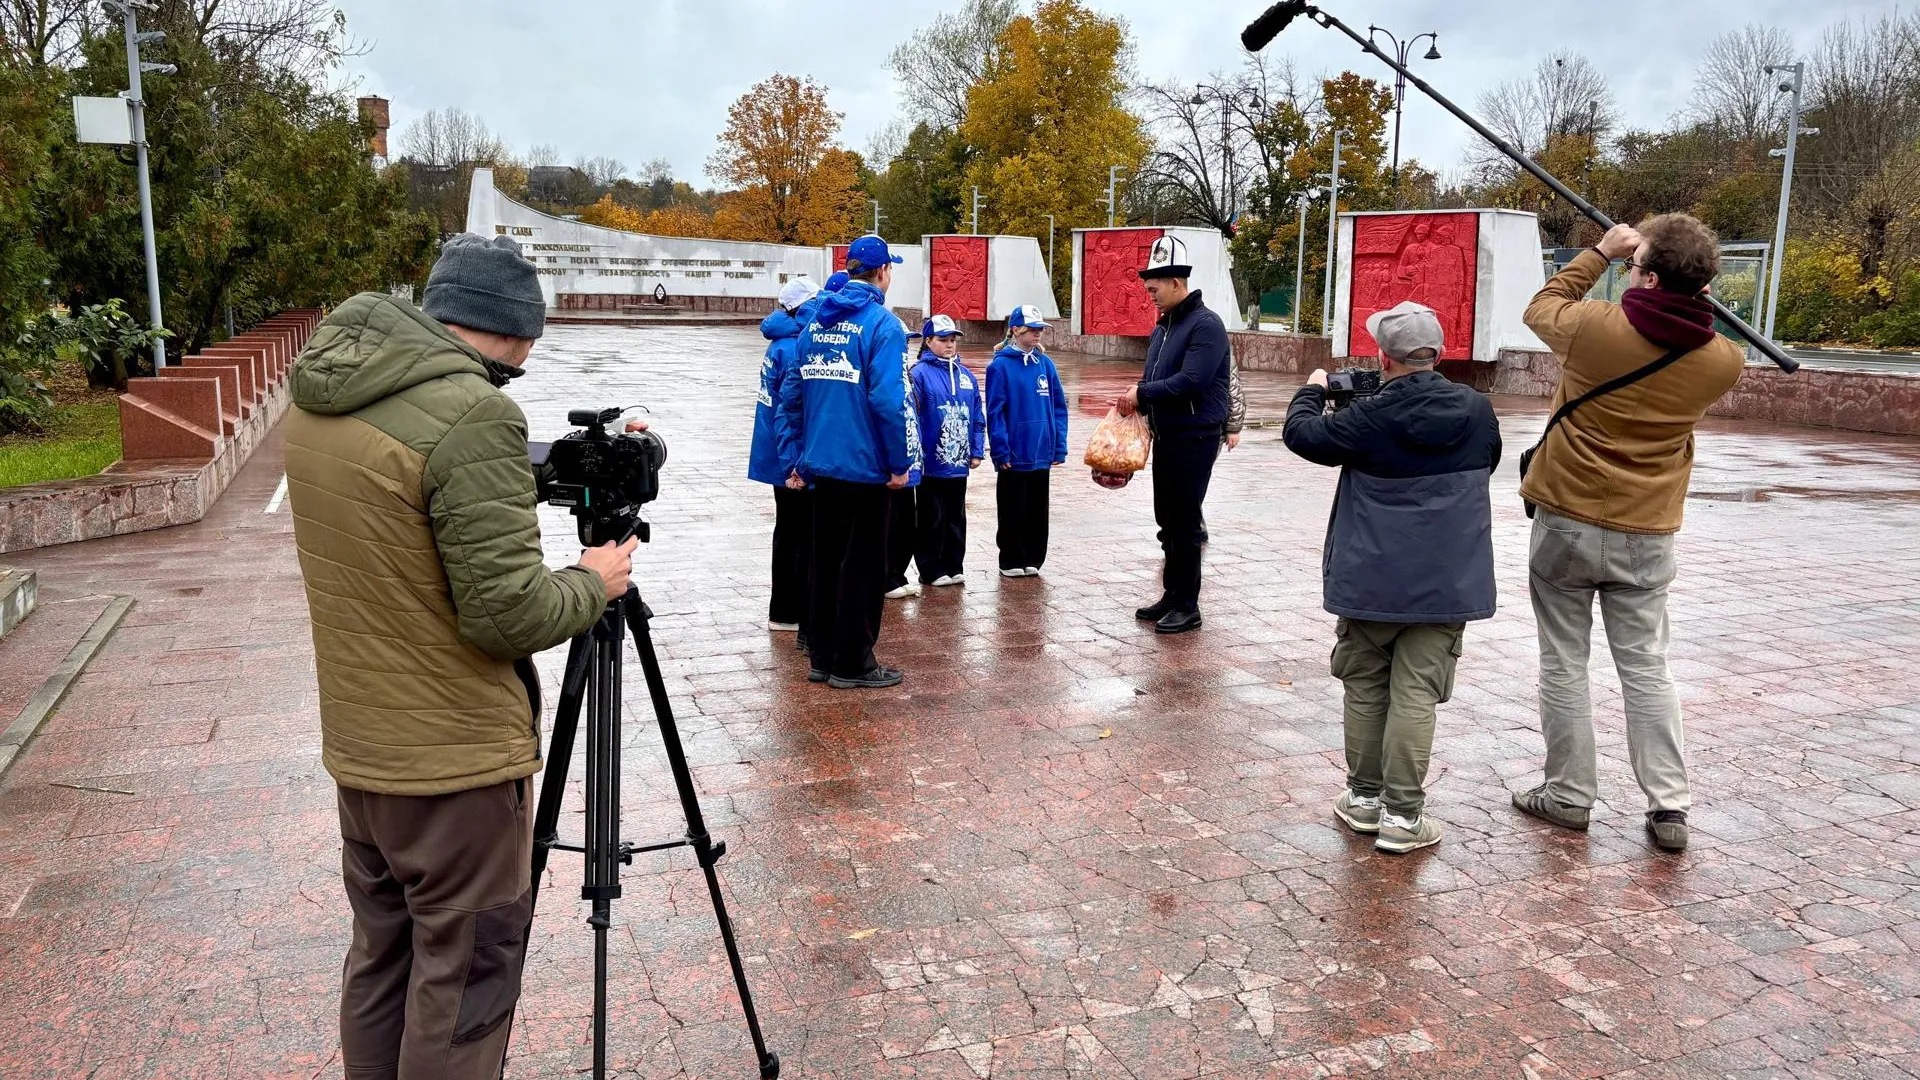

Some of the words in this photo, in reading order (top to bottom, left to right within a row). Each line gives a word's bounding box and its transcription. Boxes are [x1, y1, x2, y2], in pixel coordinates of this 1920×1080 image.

[537, 268, 566, 276] ВОБОДУ
[598, 269, 670, 278] НЕЗАВИСИМОСТЬ
[809, 320, 863, 335] ВОТЁРЫ
[812, 333, 850, 345] ПОБЕДЫ
[803, 369, 854, 379] ПОДМОСКОВЬЕ
[905, 418, 914, 457] ГОТОВ
